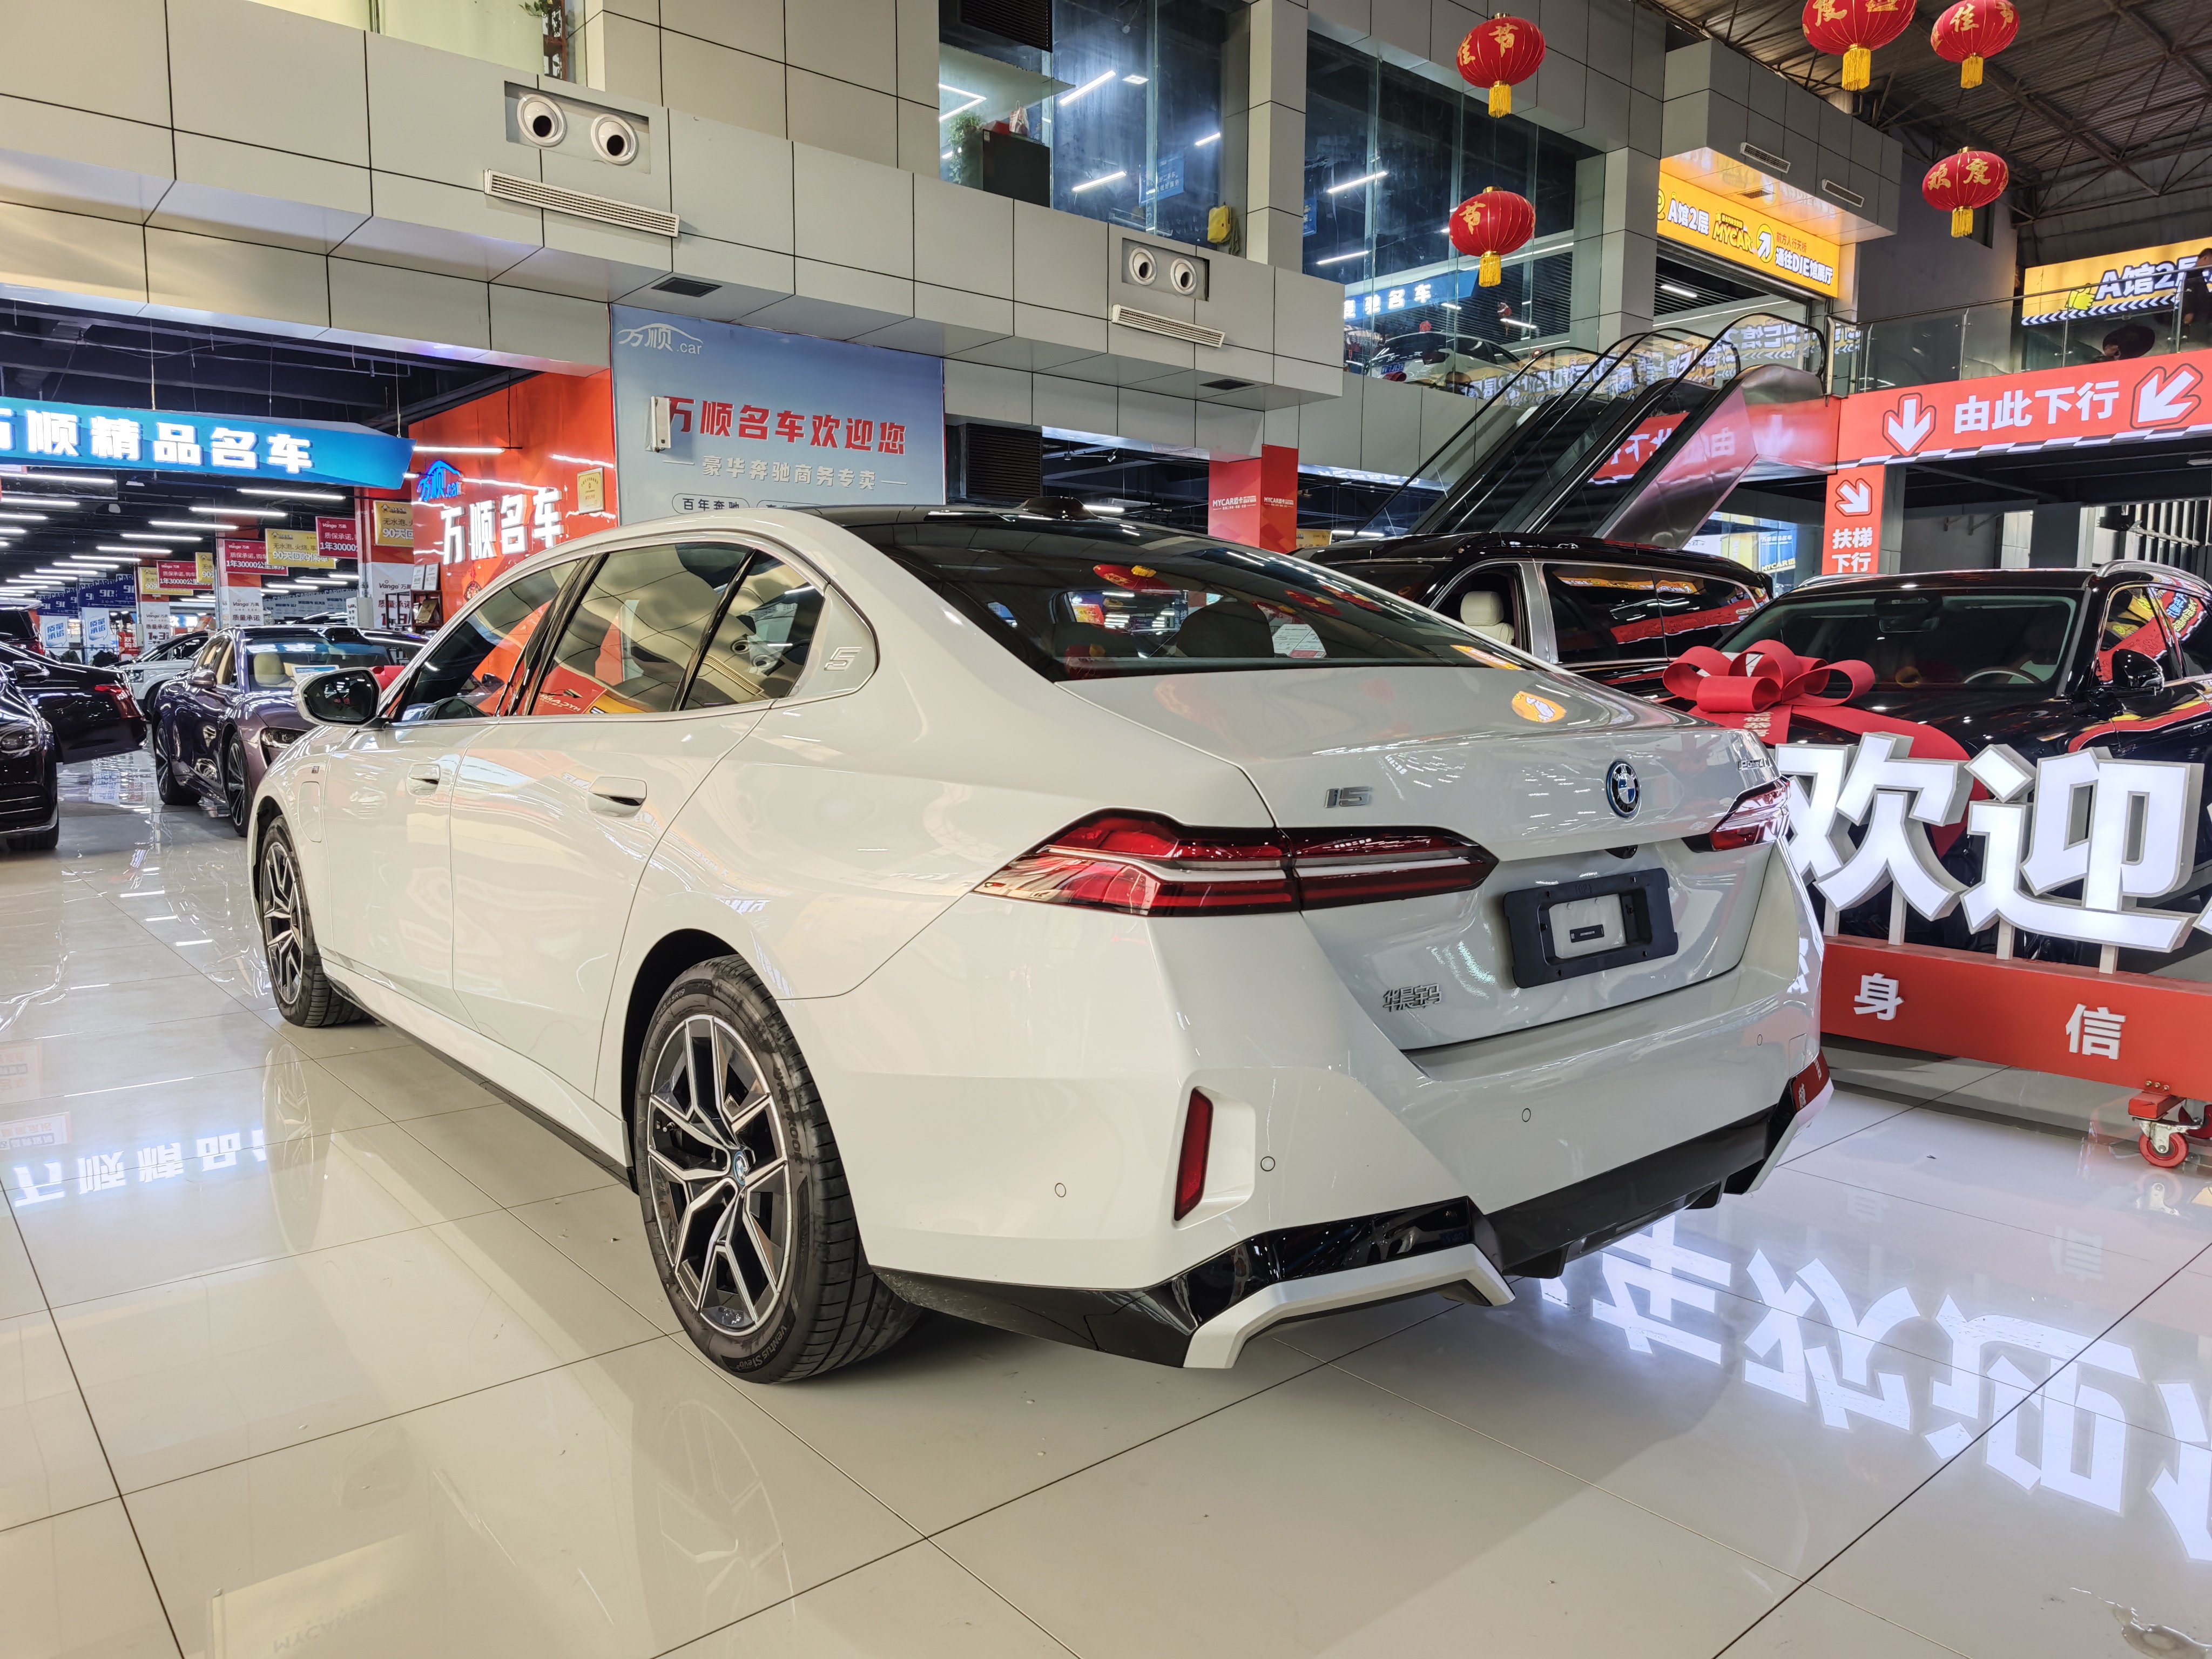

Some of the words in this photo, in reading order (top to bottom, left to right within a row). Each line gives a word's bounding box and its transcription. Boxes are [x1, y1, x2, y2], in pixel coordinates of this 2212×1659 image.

[1667, 198, 1710, 235] A馆2层
[1712, 221, 1755, 254] MYCAR
[1776, 232, 1807, 253] 前方人行天桥
[1953, 380, 2120, 434] 由此下行
[664, 396, 906, 455] 万顺名车欢迎您
[703, 455, 876, 490] 豪华奔驰商务专卖
[441, 487, 562, 565] 万顺名车
[1832, 527, 1872, 550] 扶梯
[320, 542, 357, 552] 1年30000
[1831, 552, 1872, 574] 下行
[1325, 786, 1371, 808] i5
[1775, 732, 2212, 953] 欢迎
[1383, 983, 1442, 1012] 华晨宝马
[1853, 973, 1905, 1021] 身
[2065, 1003, 2127, 1060] 信
